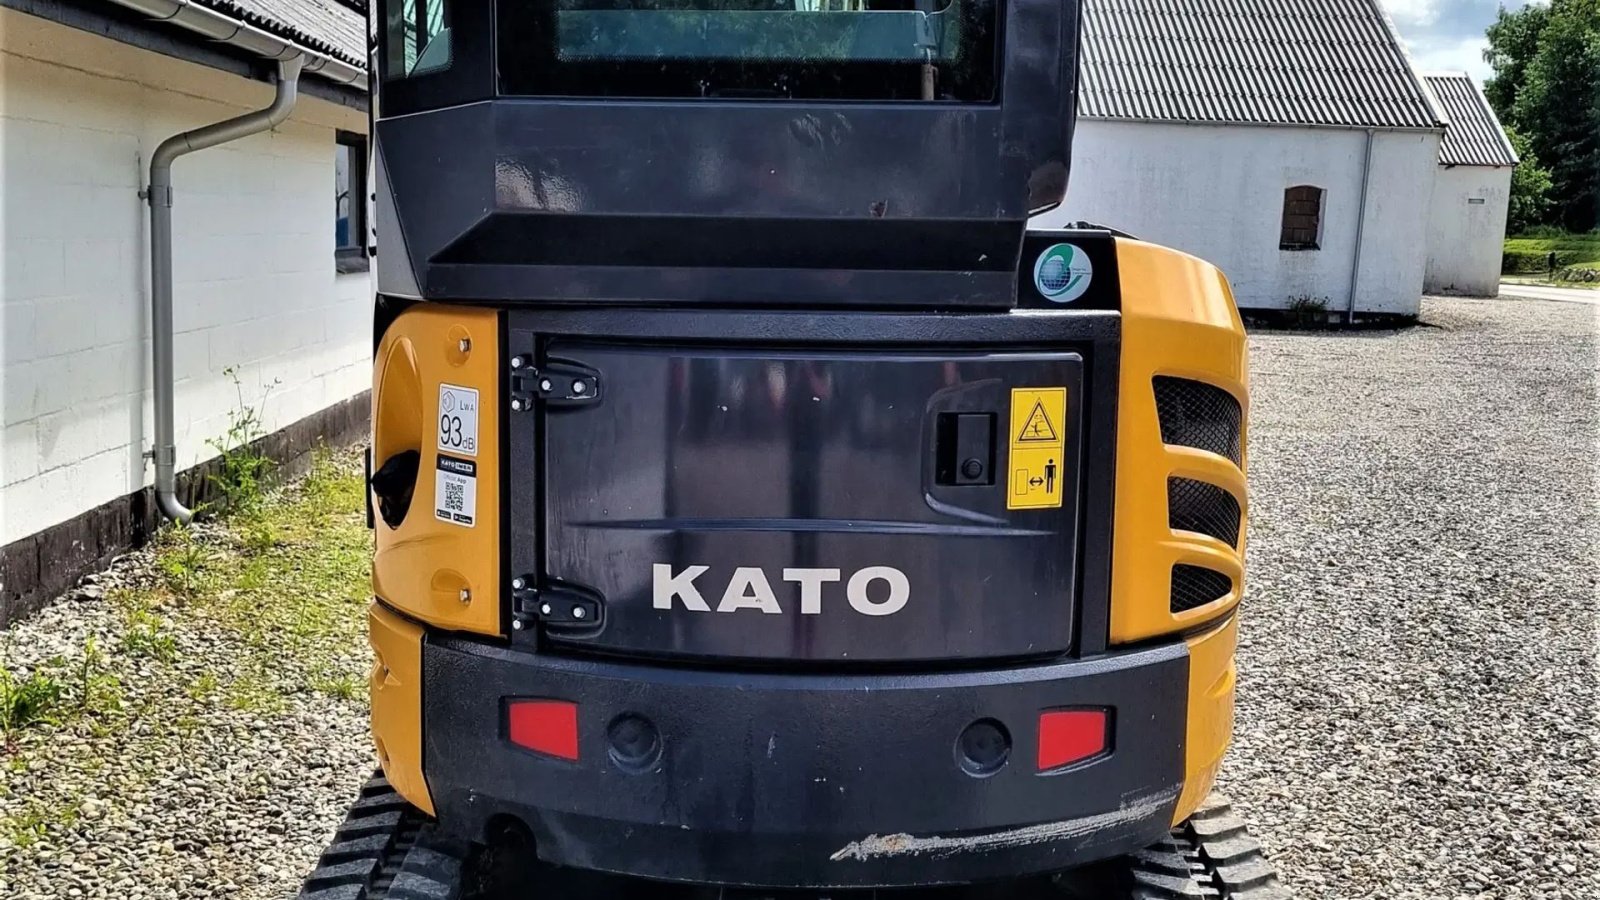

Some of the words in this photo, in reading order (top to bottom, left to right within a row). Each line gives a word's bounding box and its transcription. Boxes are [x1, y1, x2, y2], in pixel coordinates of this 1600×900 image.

[440, 414, 462, 447] 93
[462, 437, 474, 450] dB
[653, 563, 910, 615] KATO
